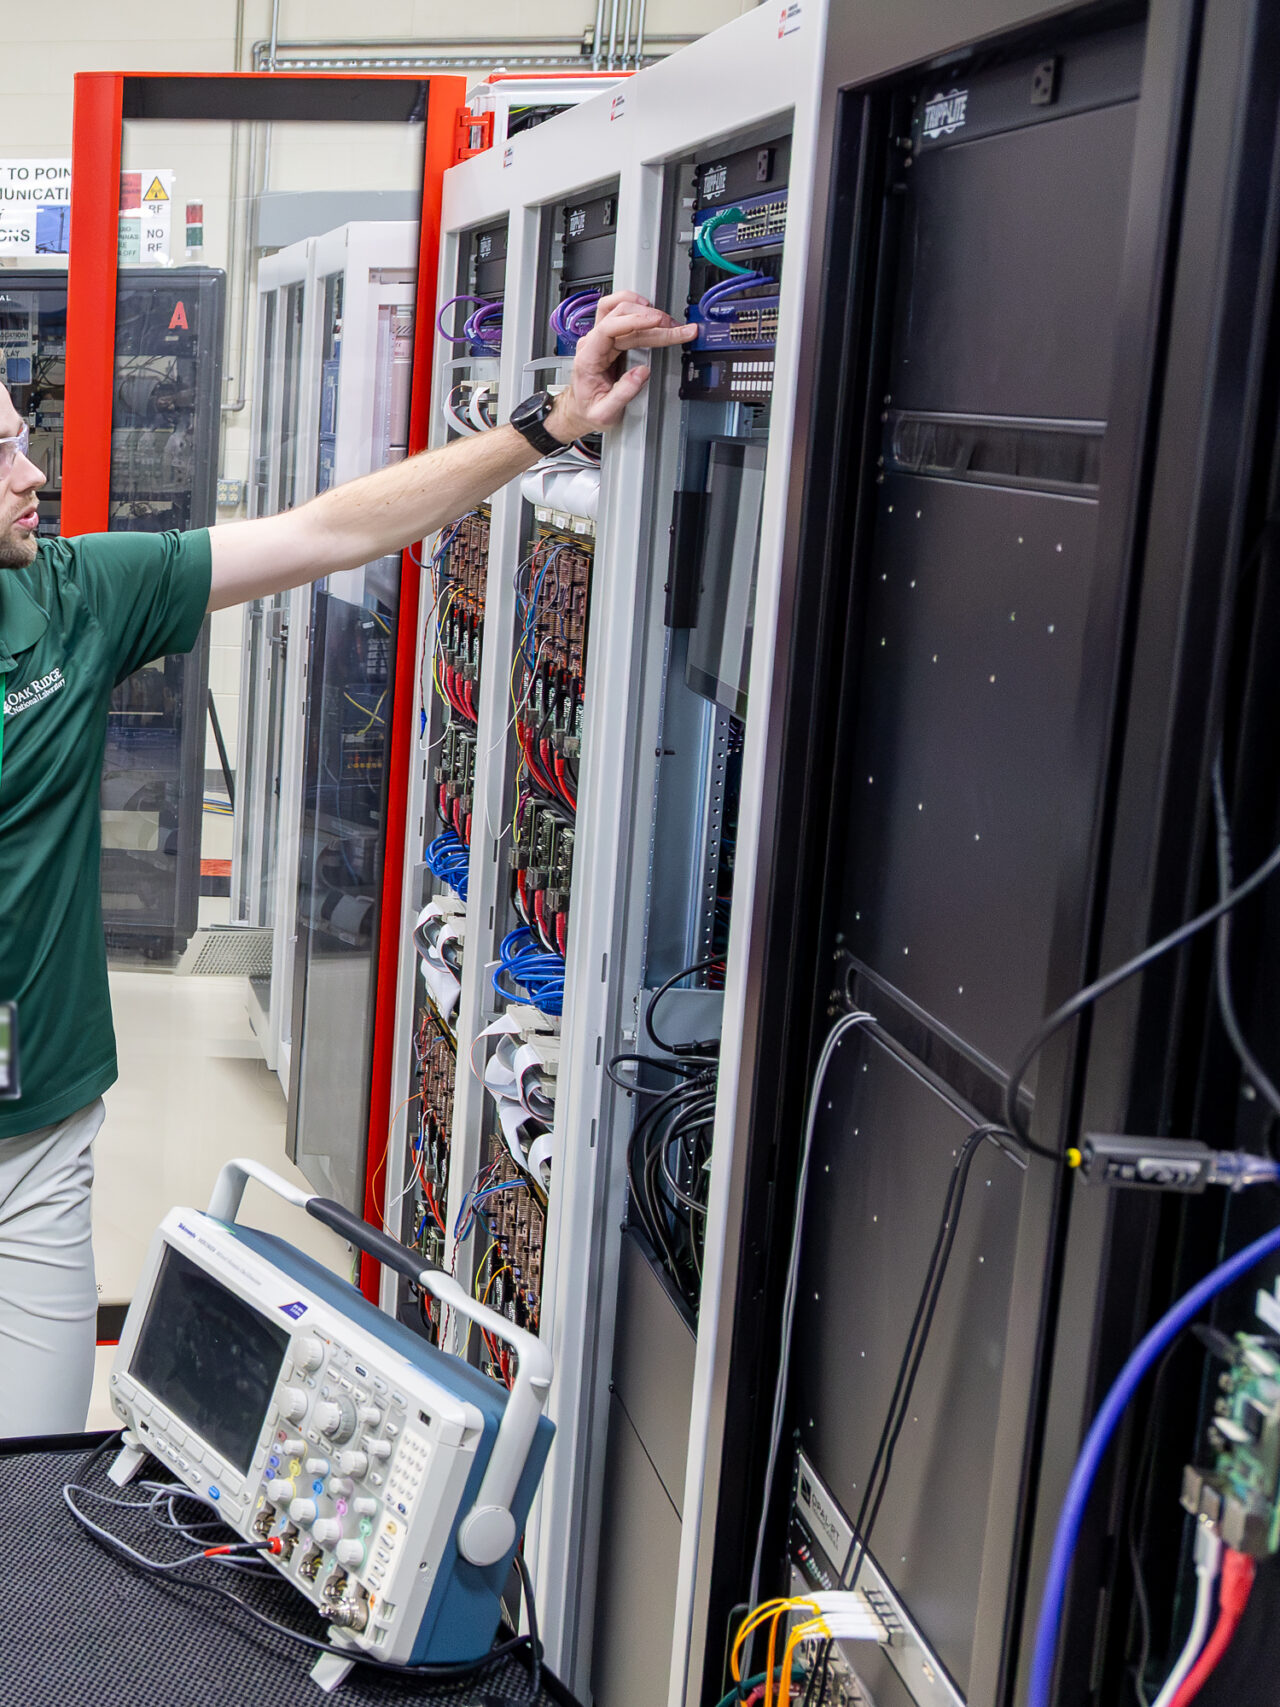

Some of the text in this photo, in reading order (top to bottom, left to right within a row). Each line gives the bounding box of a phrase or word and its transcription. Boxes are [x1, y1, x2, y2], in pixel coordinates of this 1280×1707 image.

[8, 168, 29, 180] TO
[149, 204, 163, 213] RF
[147, 229, 163, 238] NO
[147, 243, 162, 252] RF
[168, 301, 188, 330] A
[7, 667, 62, 705] OAK RIDGE
[13, 678, 65, 714] National Laboratory
